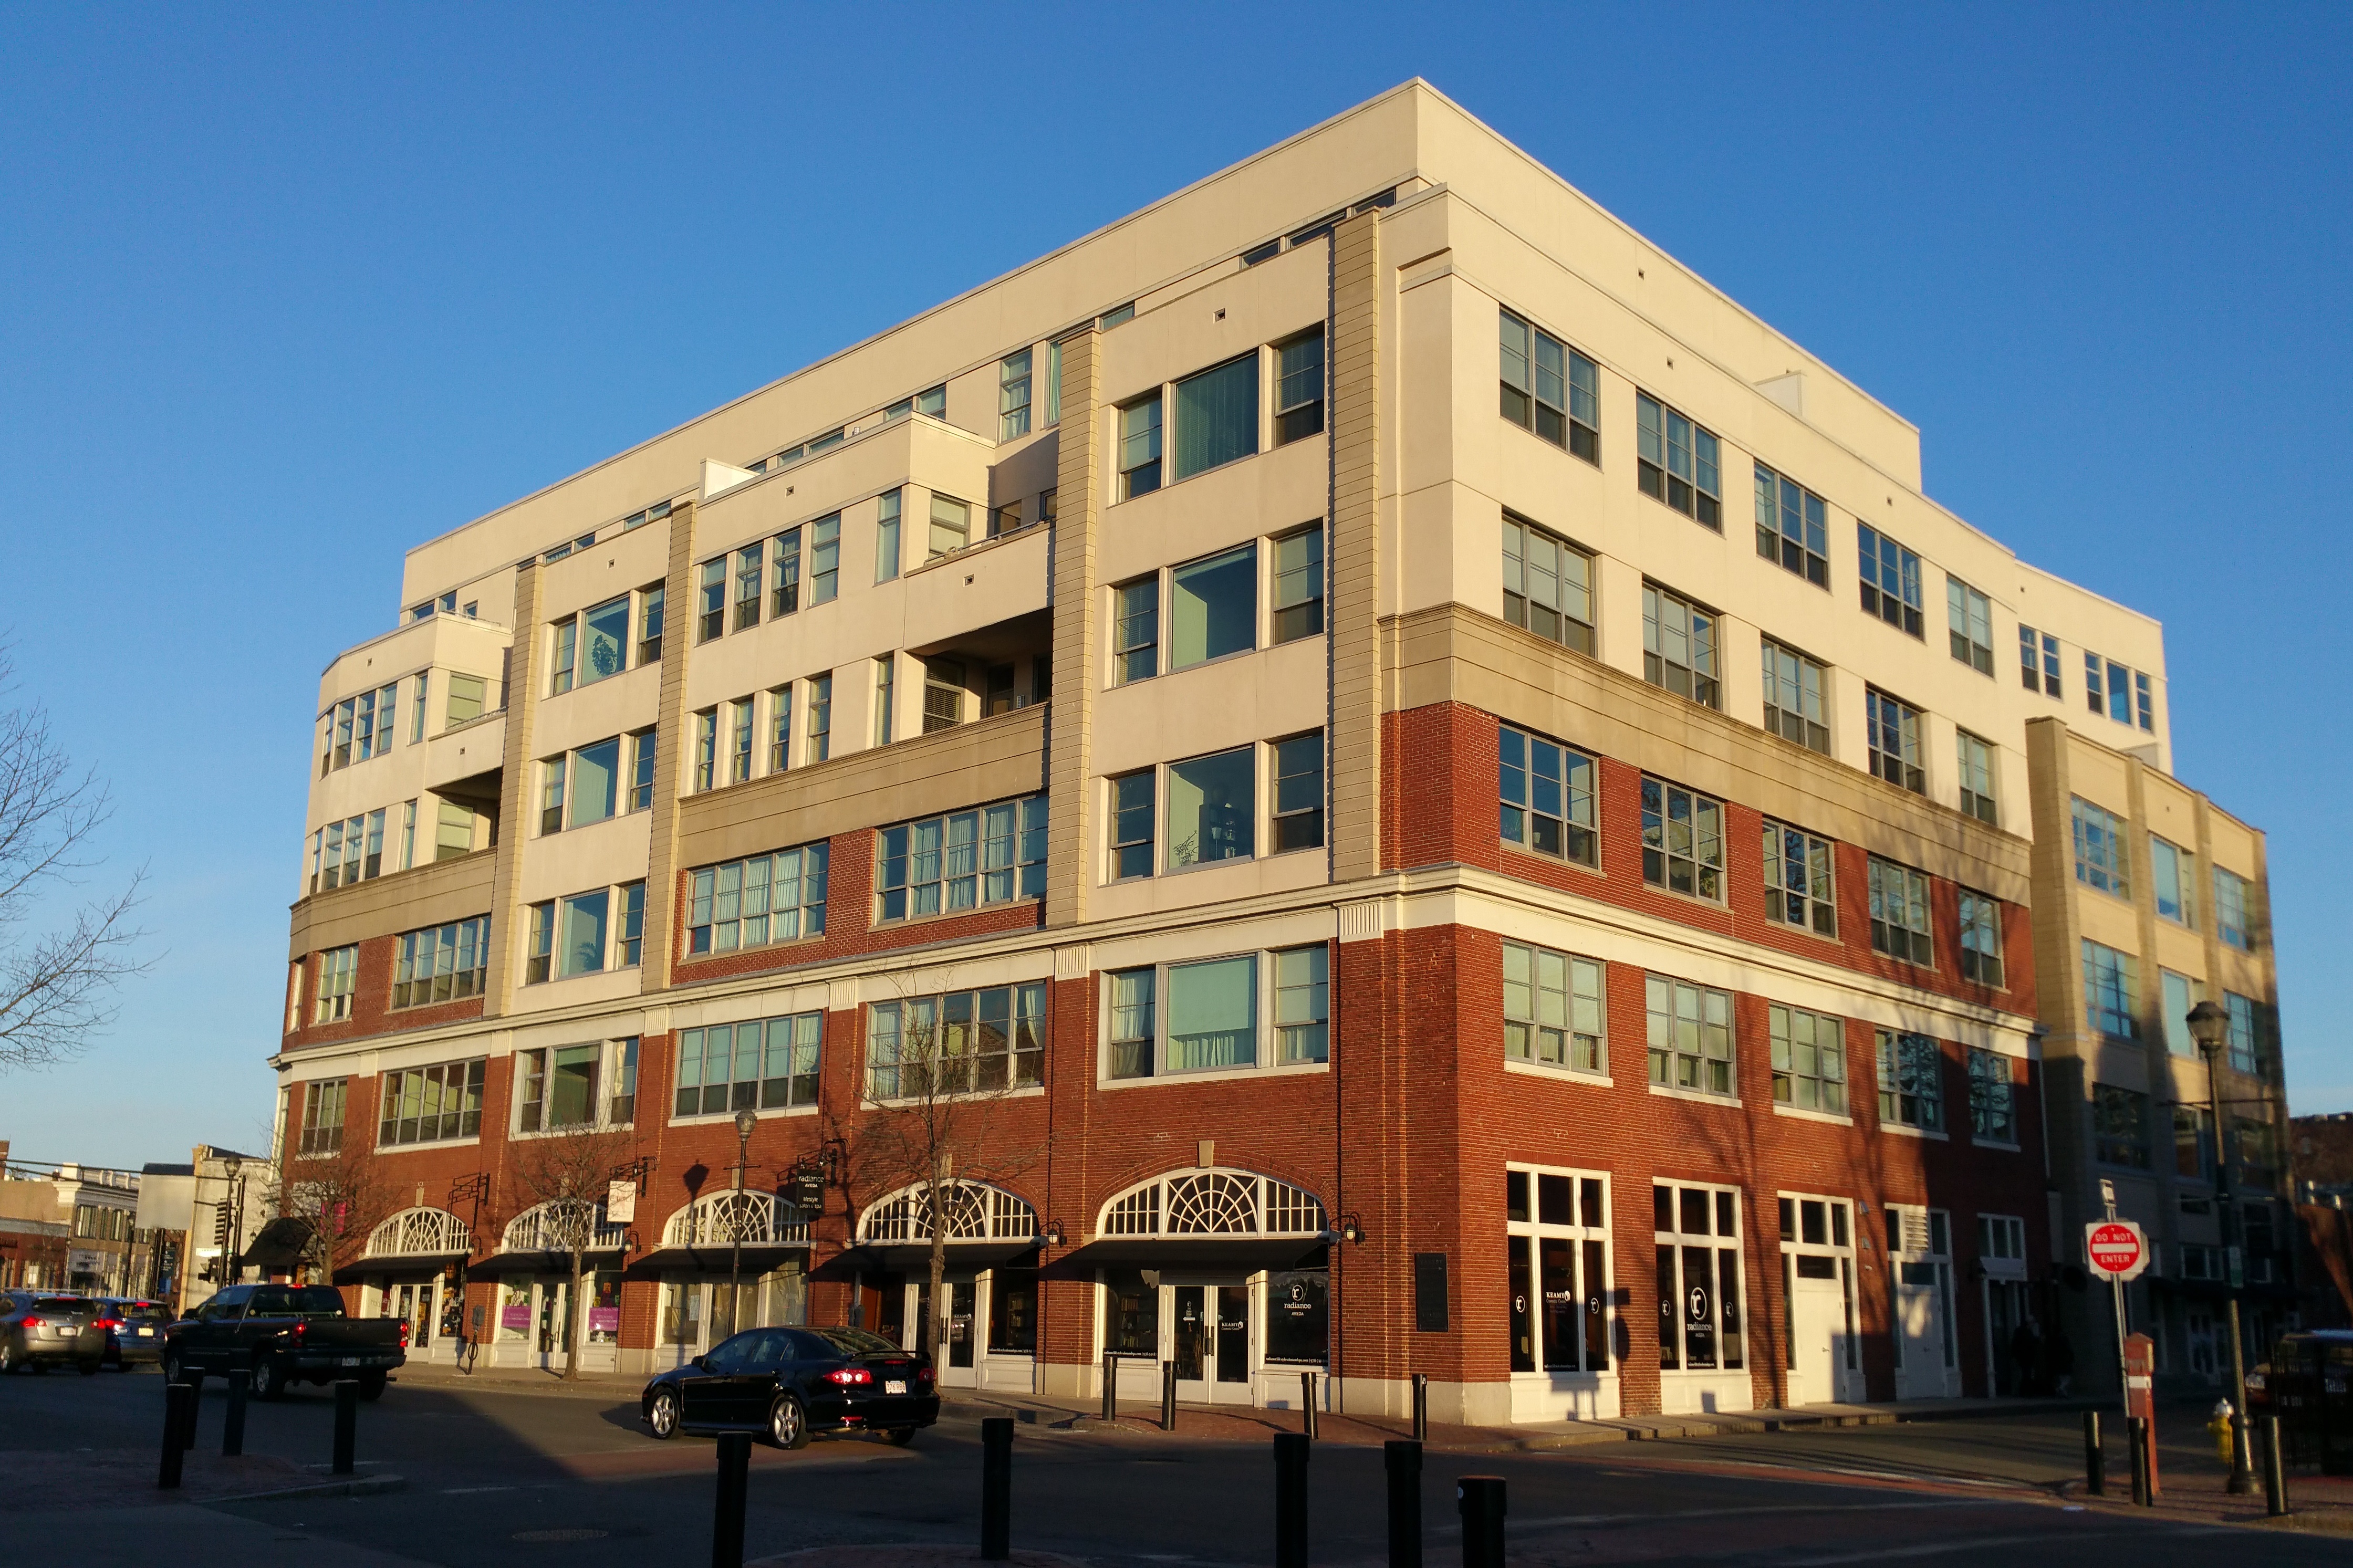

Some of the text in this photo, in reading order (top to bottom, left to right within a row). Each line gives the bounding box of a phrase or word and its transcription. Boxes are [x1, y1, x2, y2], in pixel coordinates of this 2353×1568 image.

[2095, 1233, 2131, 1242] DO NOT
[2100, 1255, 2130, 1263] ENTER
[1687, 1322, 1712, 1331] radiance
